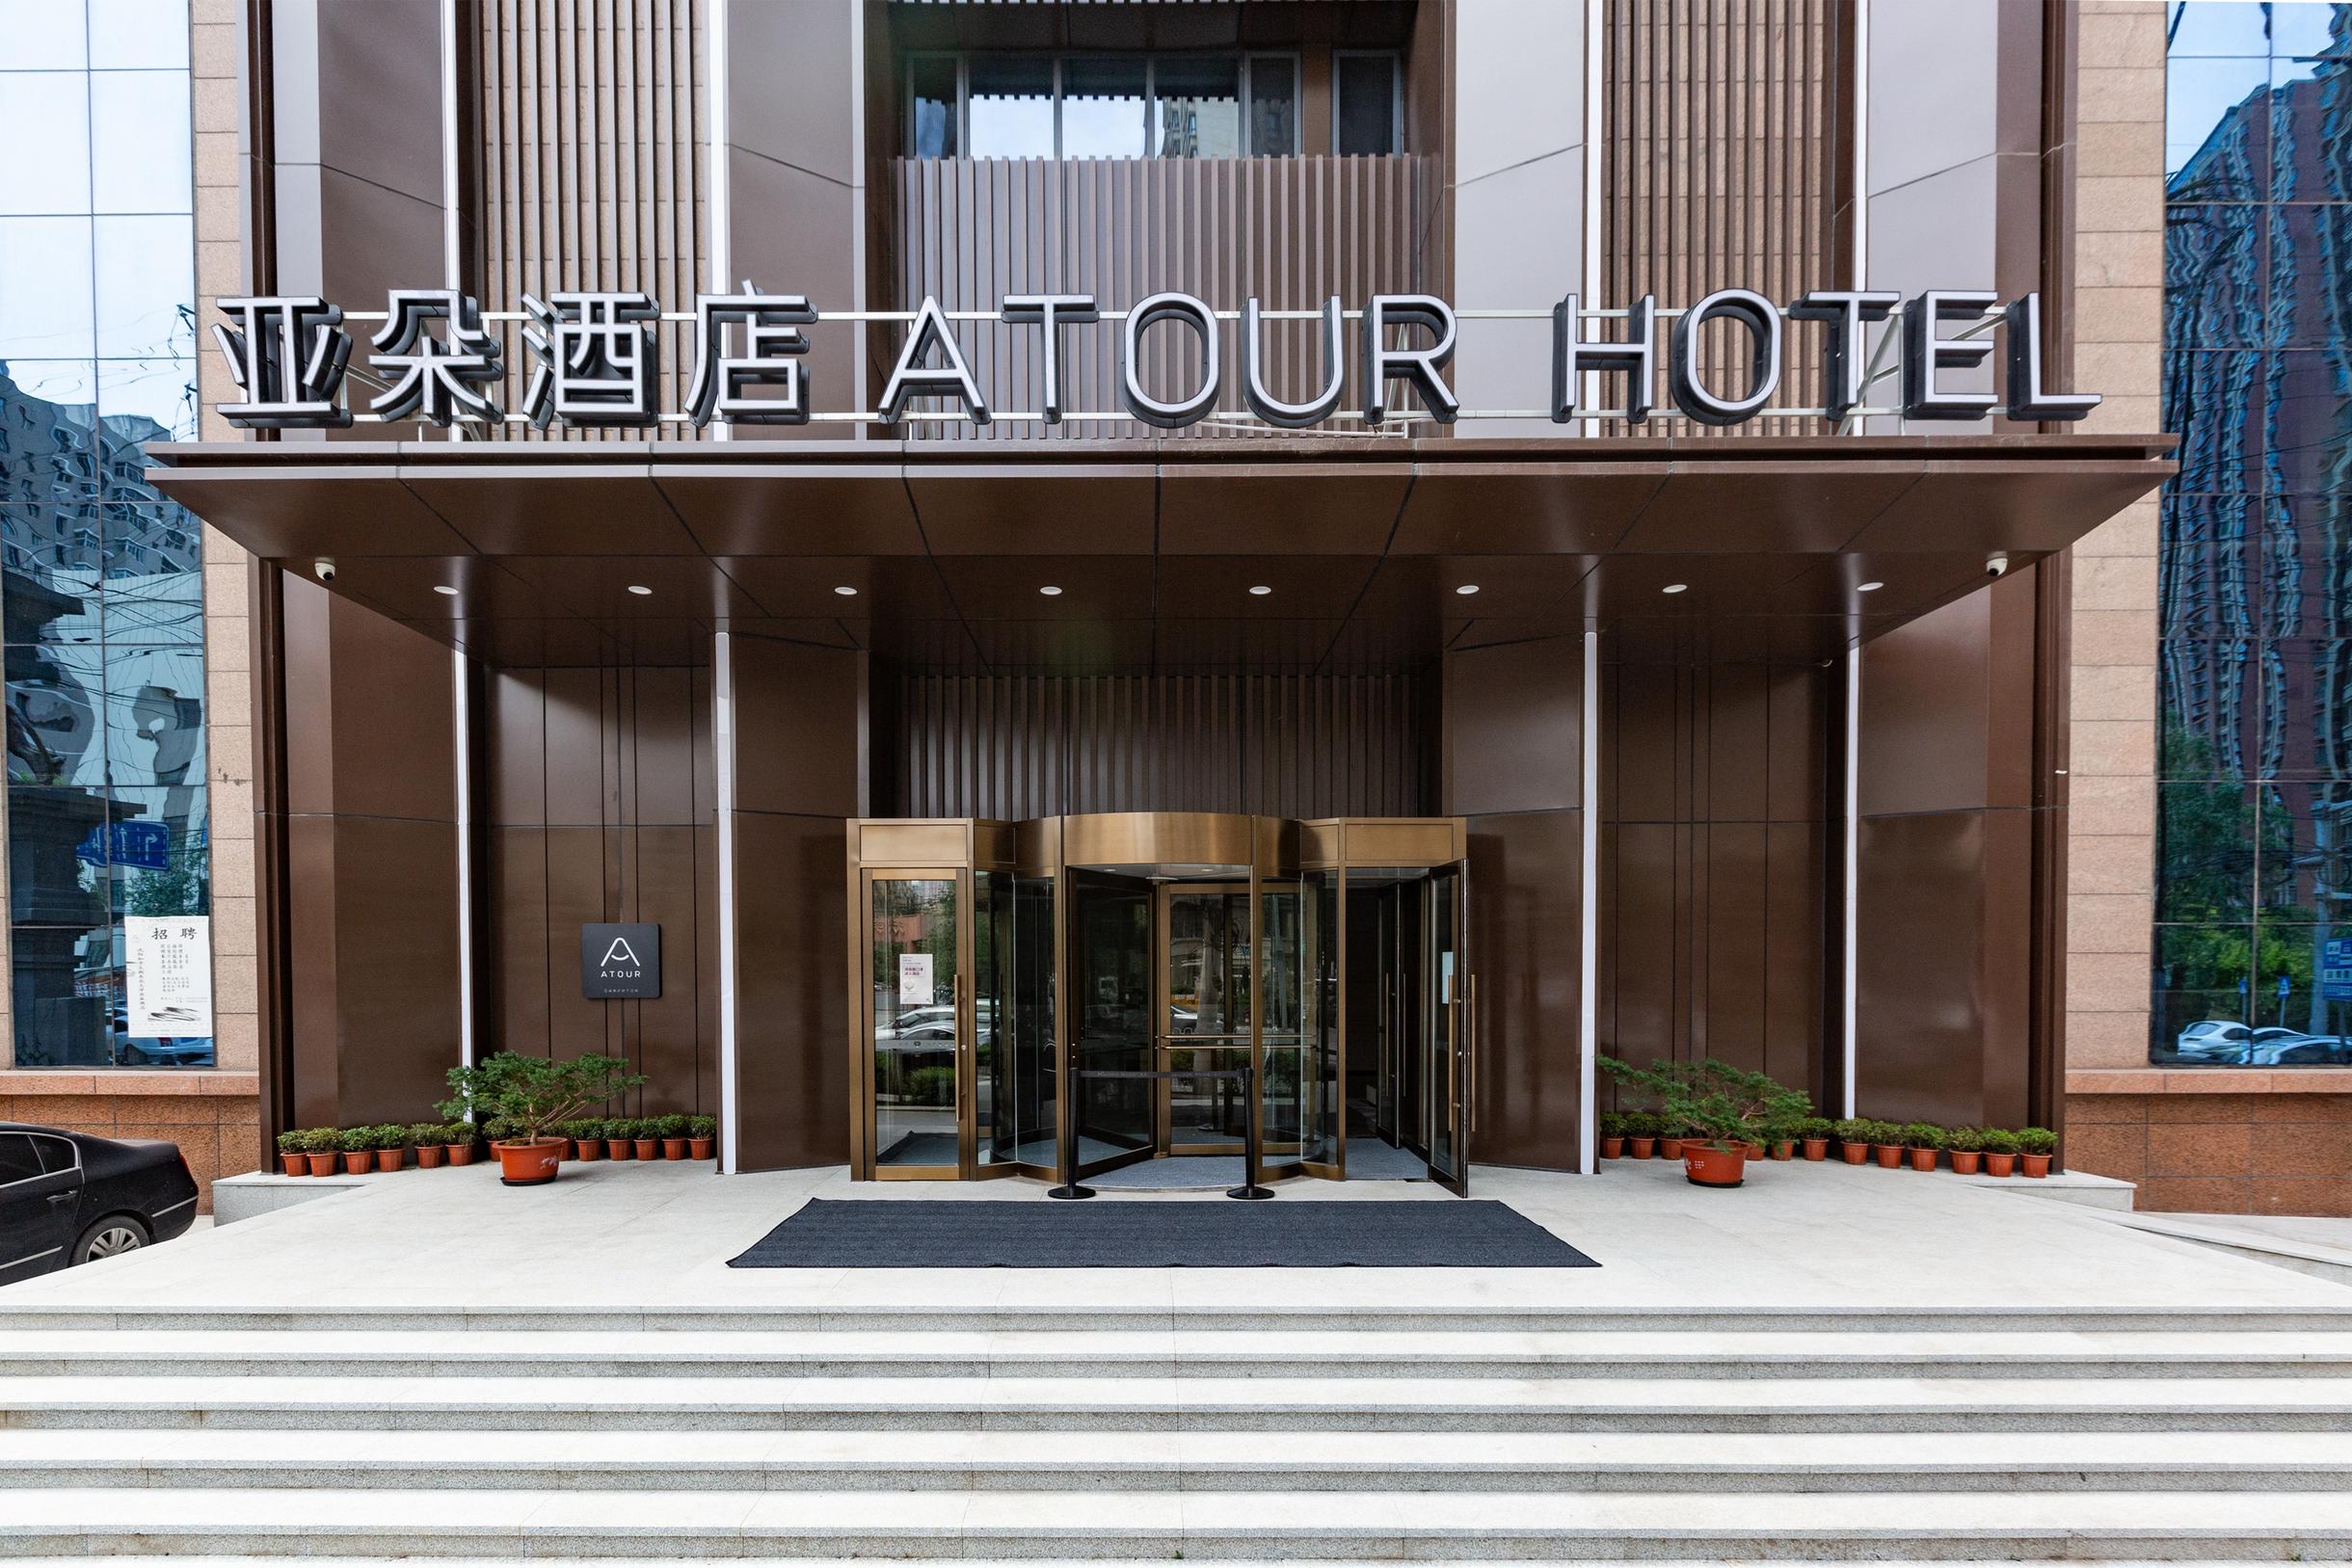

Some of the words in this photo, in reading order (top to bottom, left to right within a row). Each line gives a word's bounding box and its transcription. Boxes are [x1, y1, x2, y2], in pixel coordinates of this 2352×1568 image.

[211, 279, 818, 428] 亚朵酒店
[878, 291, 1459, 428] ATOUR
[1552, 288, 2102, 426] HOTEL
[151, 926, 198, 941] 招聘
